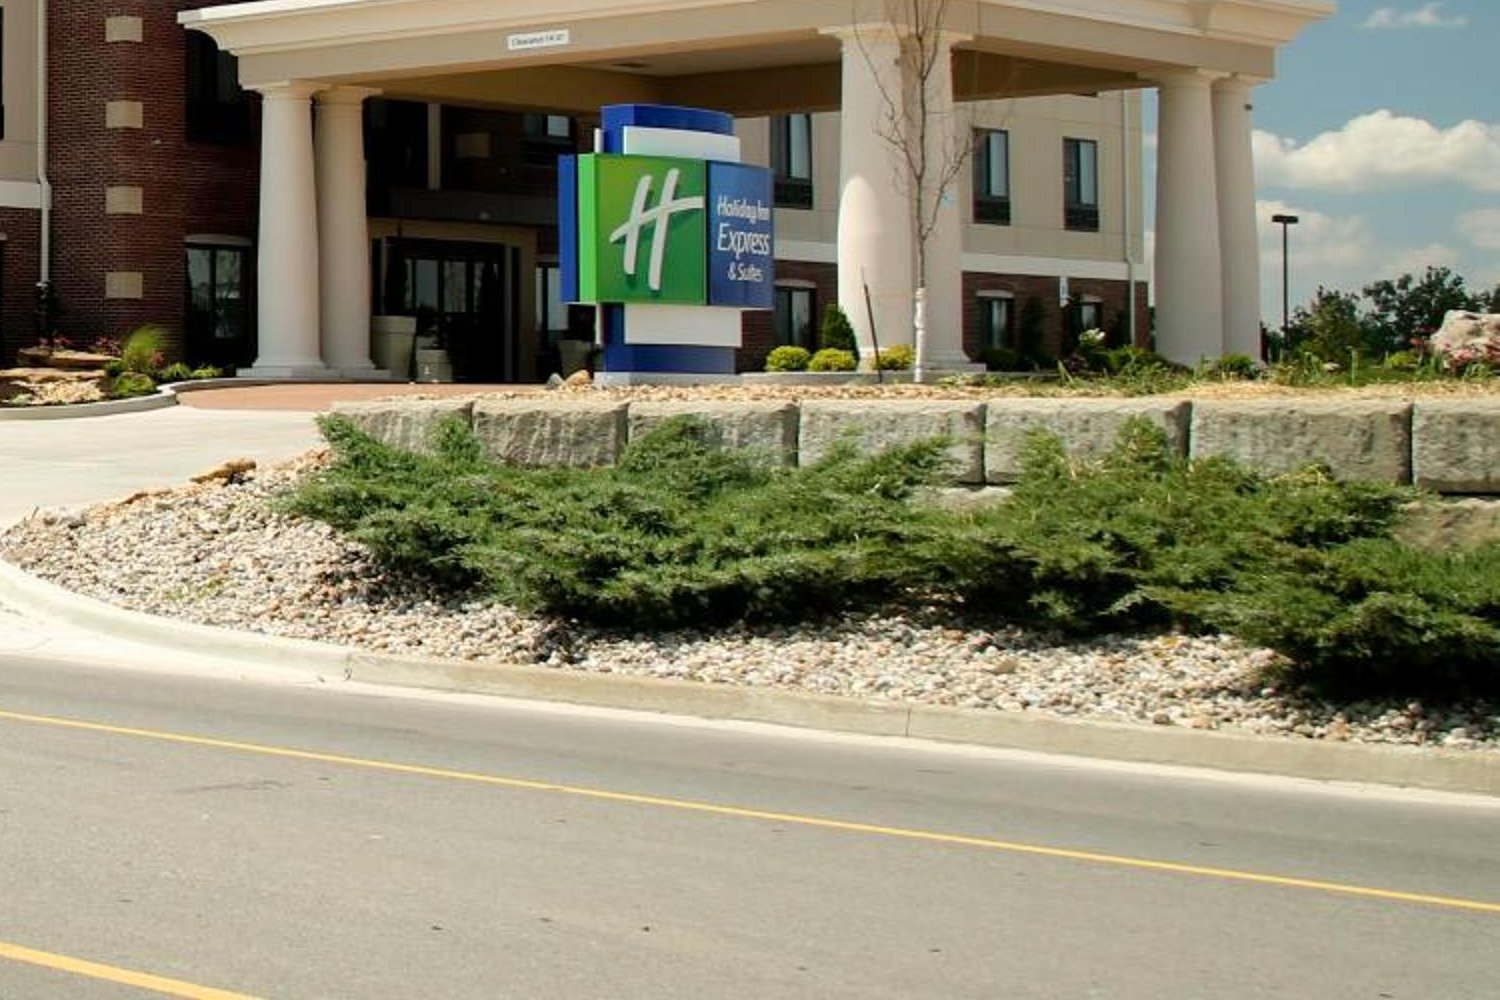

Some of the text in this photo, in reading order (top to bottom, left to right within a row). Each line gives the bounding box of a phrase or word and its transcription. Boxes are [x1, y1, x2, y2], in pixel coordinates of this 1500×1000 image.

[717, 194, 757, 225] Holiday
[717, 222, 770, 260] Express
[728, 261, 764, 283] & Suites
